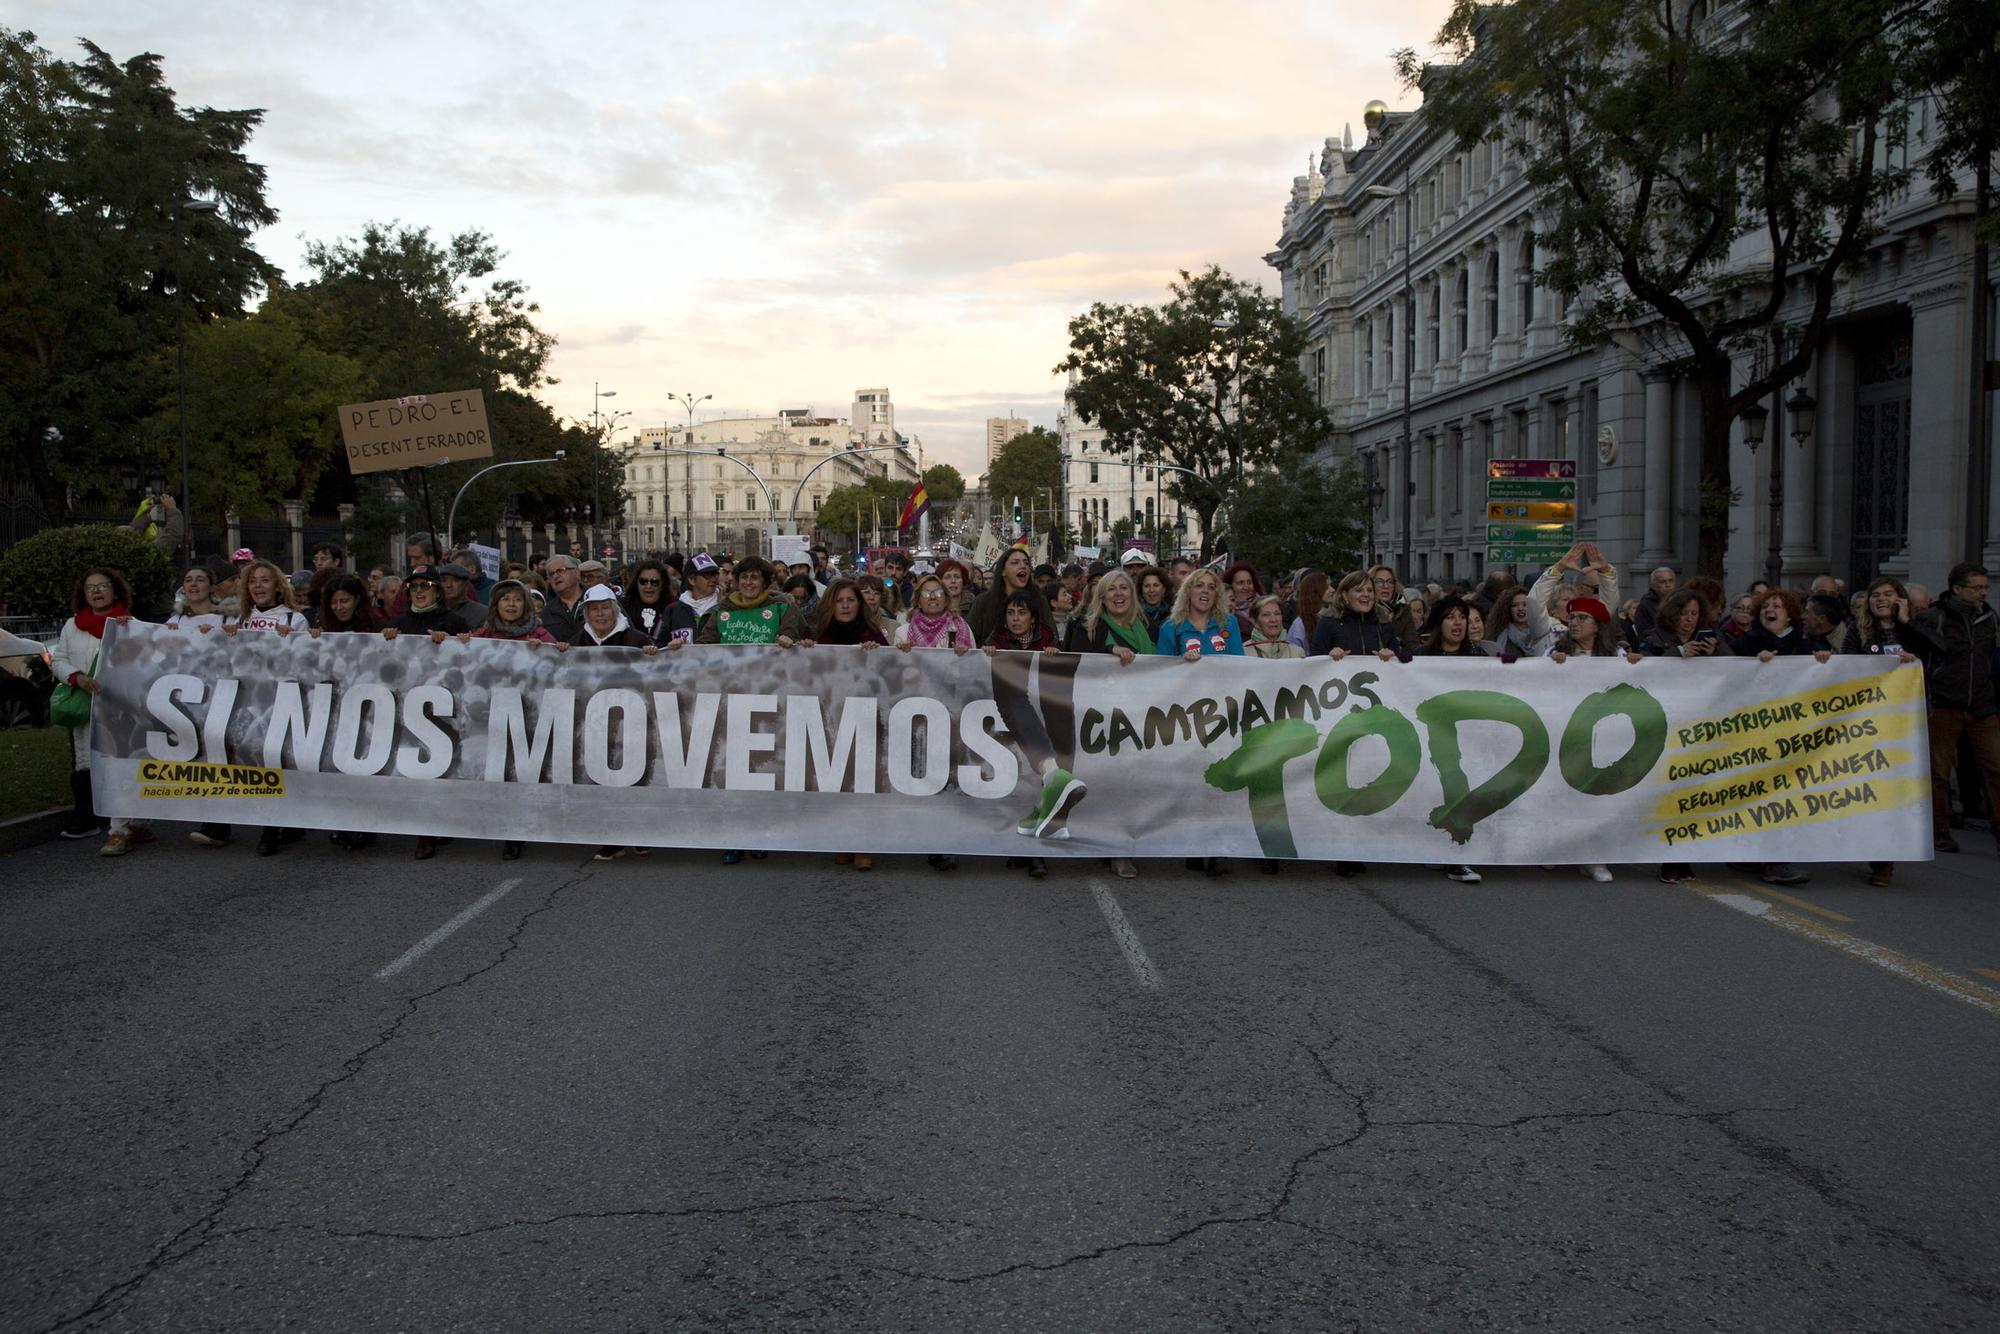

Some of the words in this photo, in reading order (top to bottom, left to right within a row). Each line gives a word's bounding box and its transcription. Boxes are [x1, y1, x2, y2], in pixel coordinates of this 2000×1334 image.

[349, 430, 487, 458] DESENTERRADOR
[146, 674, 239, 764] SI
[263, 680, 454, 780] NOS
[484, 686, 1018, 799] MOVEMOS
[1080, 671, 1380, 755] CAMBIAMOS
[1678, 702, 1807, 748] REDISTRIBUIR
[1812, 687, 1886, 717] RIQUEZA
[142, 763, 280, 787] CAMINANDO
[1204, 683, 1668, 858] TODO
[1669, 747, 1771, 781] CONQUISTAR
[1776, 720, 1878, 759] DERECHOS
[1678, 780, 1768, 814] RECUPERAR
[1773, 775, 1791, 791] EL
[1795, 749, 1890, 789] PLANETA
[144, 786, 171, 796] hacia
[174, 786, 183, 796] el
[185, 787, 199, 796] 24
[202, 788, 209, 797] y
[211, 787, 225, 795] 27
[227, 786, 240, 795] de
[242, 786, 283, 795] octubre
[1664, 823, 1703, 846] POR
[1707, 812, 1745, 834] UNA
[1748, 799, 1798, 828] VIDA
[1803, 783, 1877, 817] DIGNA
